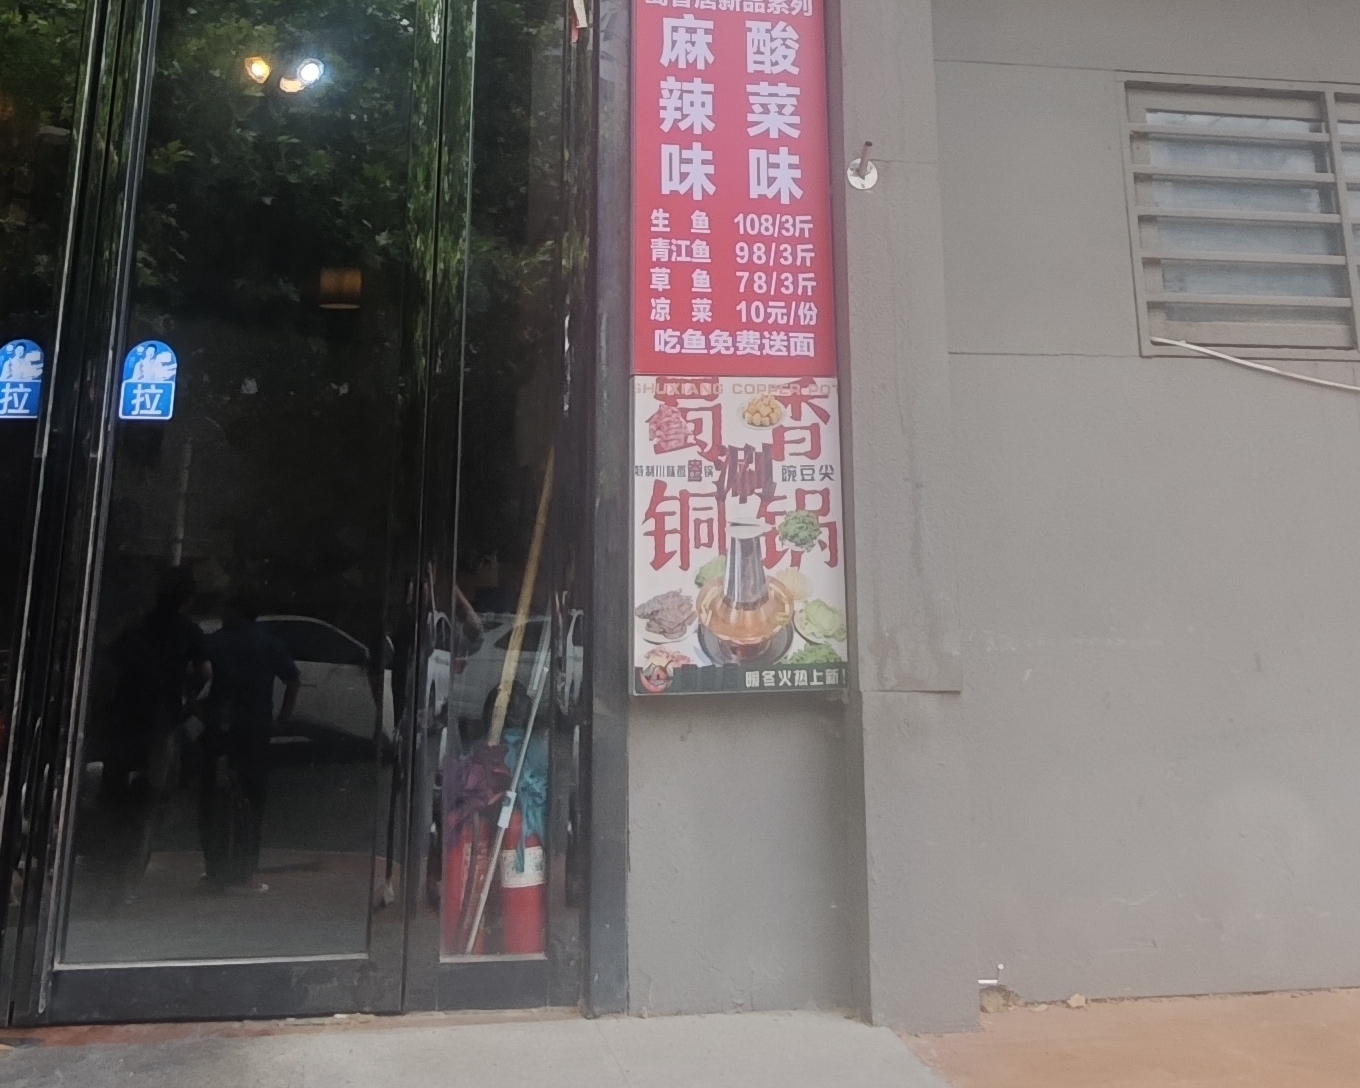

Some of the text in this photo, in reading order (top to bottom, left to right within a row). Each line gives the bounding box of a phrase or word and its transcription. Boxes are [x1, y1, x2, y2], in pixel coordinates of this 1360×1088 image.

[659, 13, 716, 202] 麻辣味
[744, 18, 803, 205] 酸菜味
[734, 214, 814, 238] 108/3斤
[649, 238, 815, 267] 青江鱼 98/3斤
[735, 271, 817, 296] 78/3斤
[736, 300, 818, 326] 10元/份
[654, 327, 816, 359] 吃鱼免费送面
[131, 383, 165, 416] 拉
[732, 383, 801, 396] COPPER
[781, 464, 835, 483] 豌豆尖
